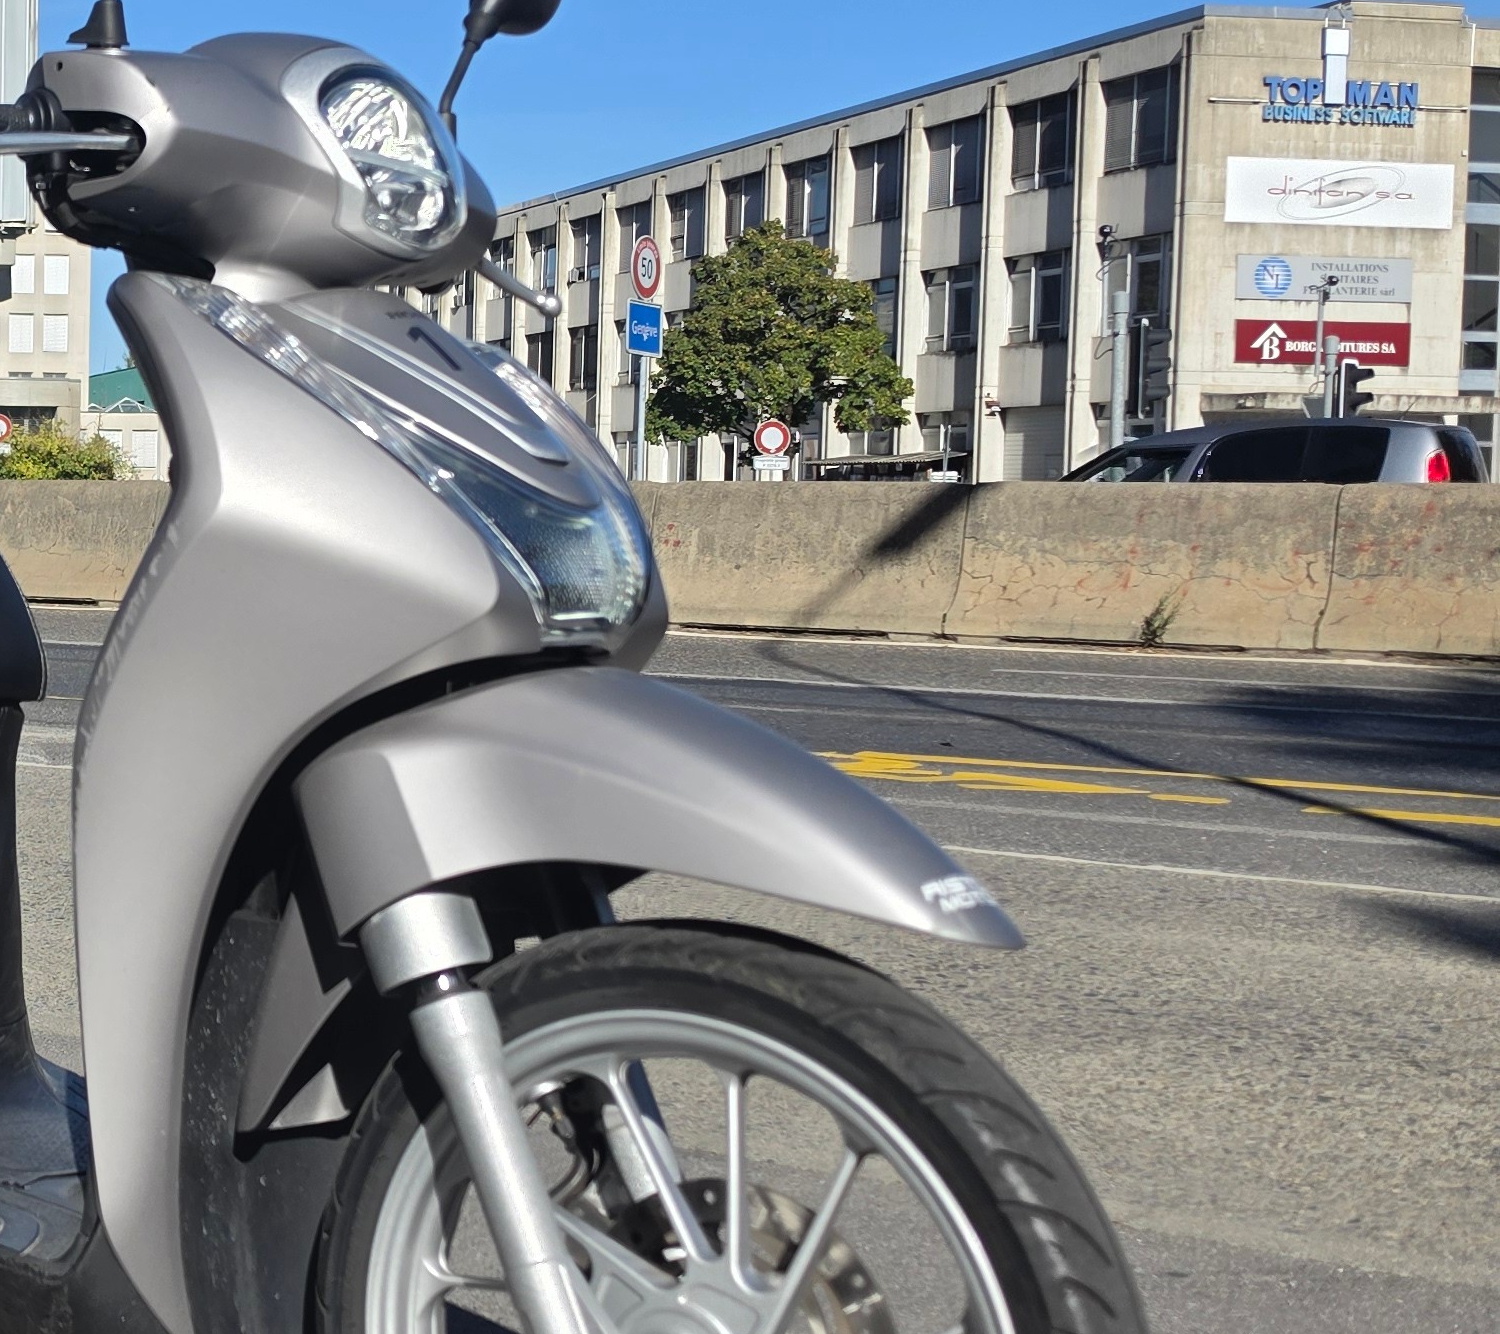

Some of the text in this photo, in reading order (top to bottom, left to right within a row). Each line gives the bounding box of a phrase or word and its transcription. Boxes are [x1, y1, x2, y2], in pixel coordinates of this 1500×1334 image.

[1263, 76, 1419, 108] TOP MAN
[1262, 105, 1417, 128] BUSINESS SOFTWARE
[641, 257, 653, 279] 50
[1311, 262, 1389, 273] INSTALLATIONS
[1320, 274, 1379, 285] SITAIRES
[1303, 285, 1378, 297] FELANTERIE
[632, 320, 658, 338] Genève
[1285, 340, 1396, 354] BORG ITURES SA
